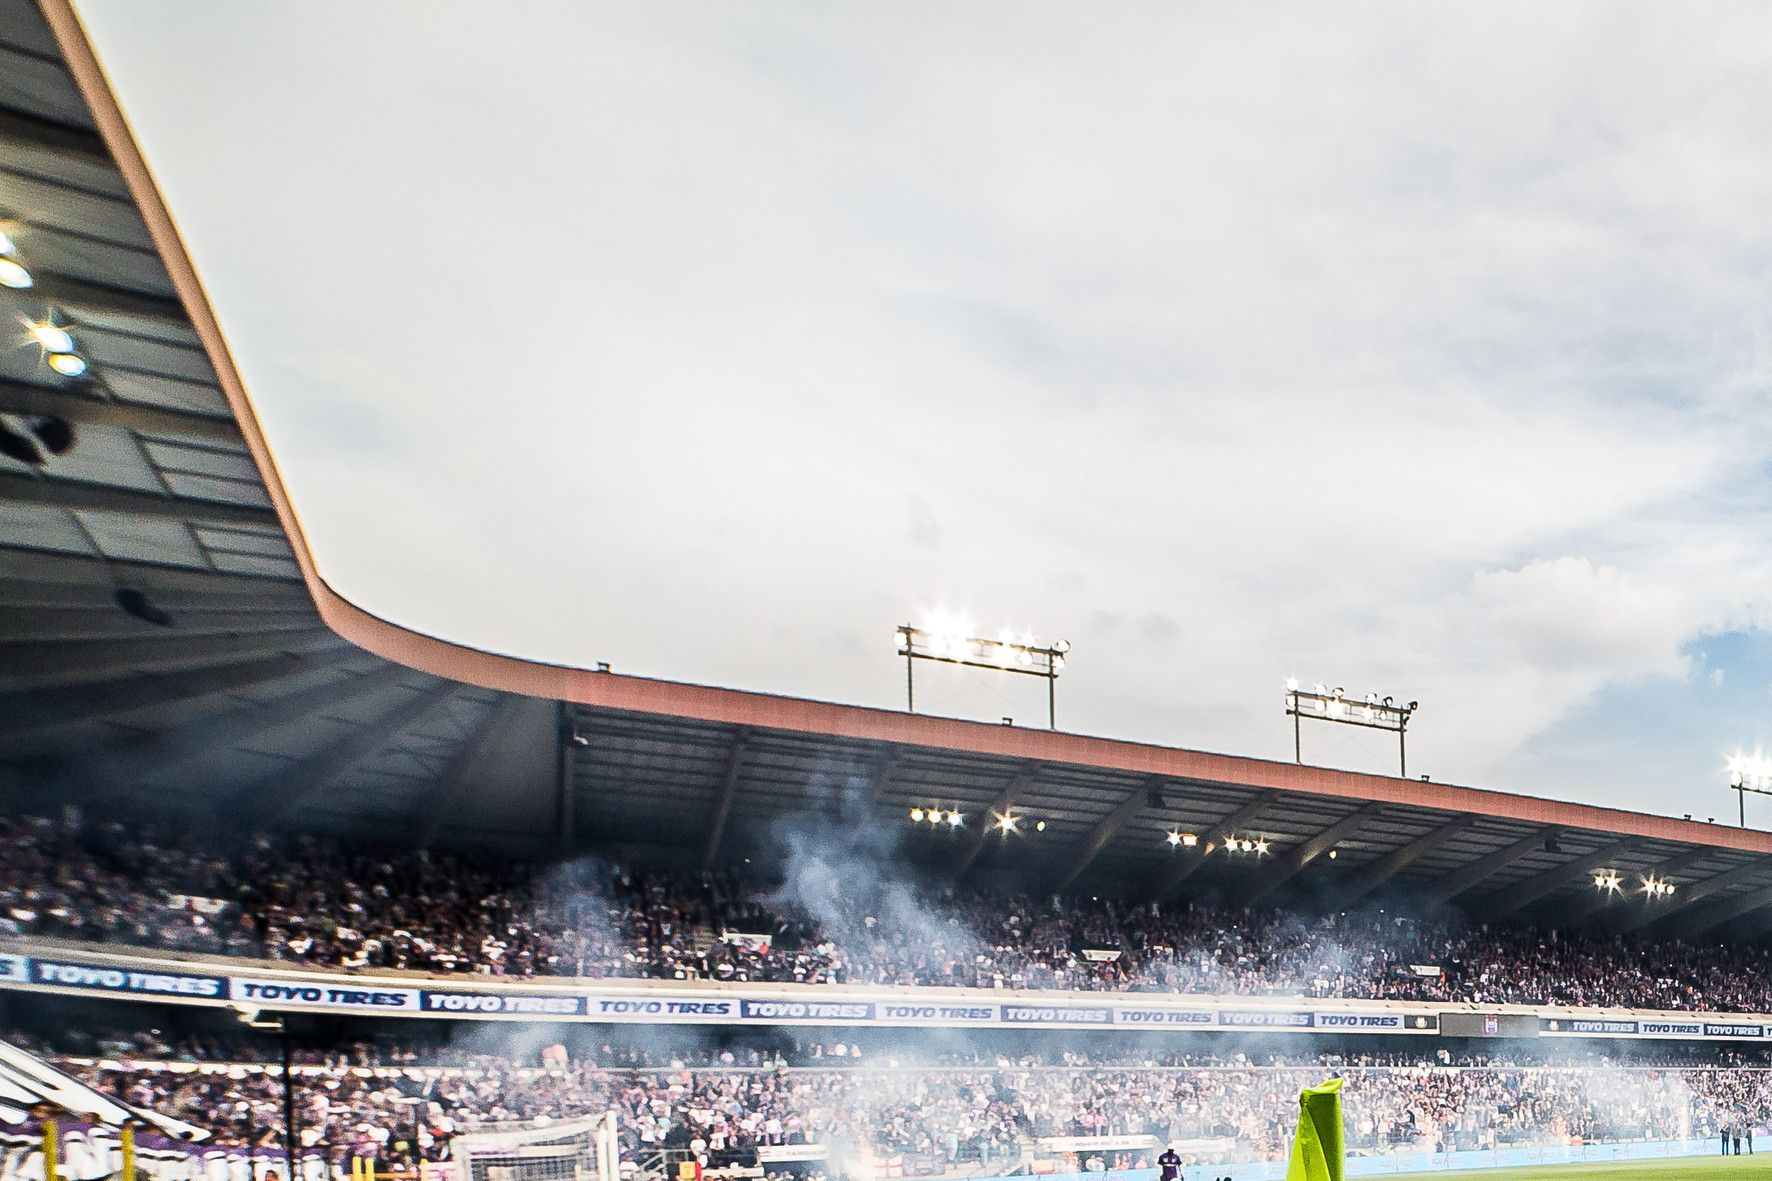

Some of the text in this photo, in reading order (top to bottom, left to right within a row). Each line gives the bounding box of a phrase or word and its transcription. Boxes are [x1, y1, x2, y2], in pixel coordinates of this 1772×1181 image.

[40, 963, 125, 987] TOYO
[244, 983, 408, 1006] TOYO TIRES
[429, 994, 502, 1011] TOYO
[599, 1000, 731, 1015] TOYO TIRES
[747, 1003, 867, 1018] TOYO TIRES
[885, 1006, 992, 1019] TOYO TIRES
[1006, 1008, 1106, 1022] TOYO TIRES
[1121, 1011, 1212, 1023] TOYO TIRES
[1224, 1012, 1309, 1026] TOYO TIRES
[1320, 1015, 1398, 1027] TOYO TIRES
[1572, 1021, 1635, 1032] TOYO TIRES
[1643, 1024, 1699, 1034] TOYO TIRES
[1707, 1025, 1760, 1035] TOYO TIRES
